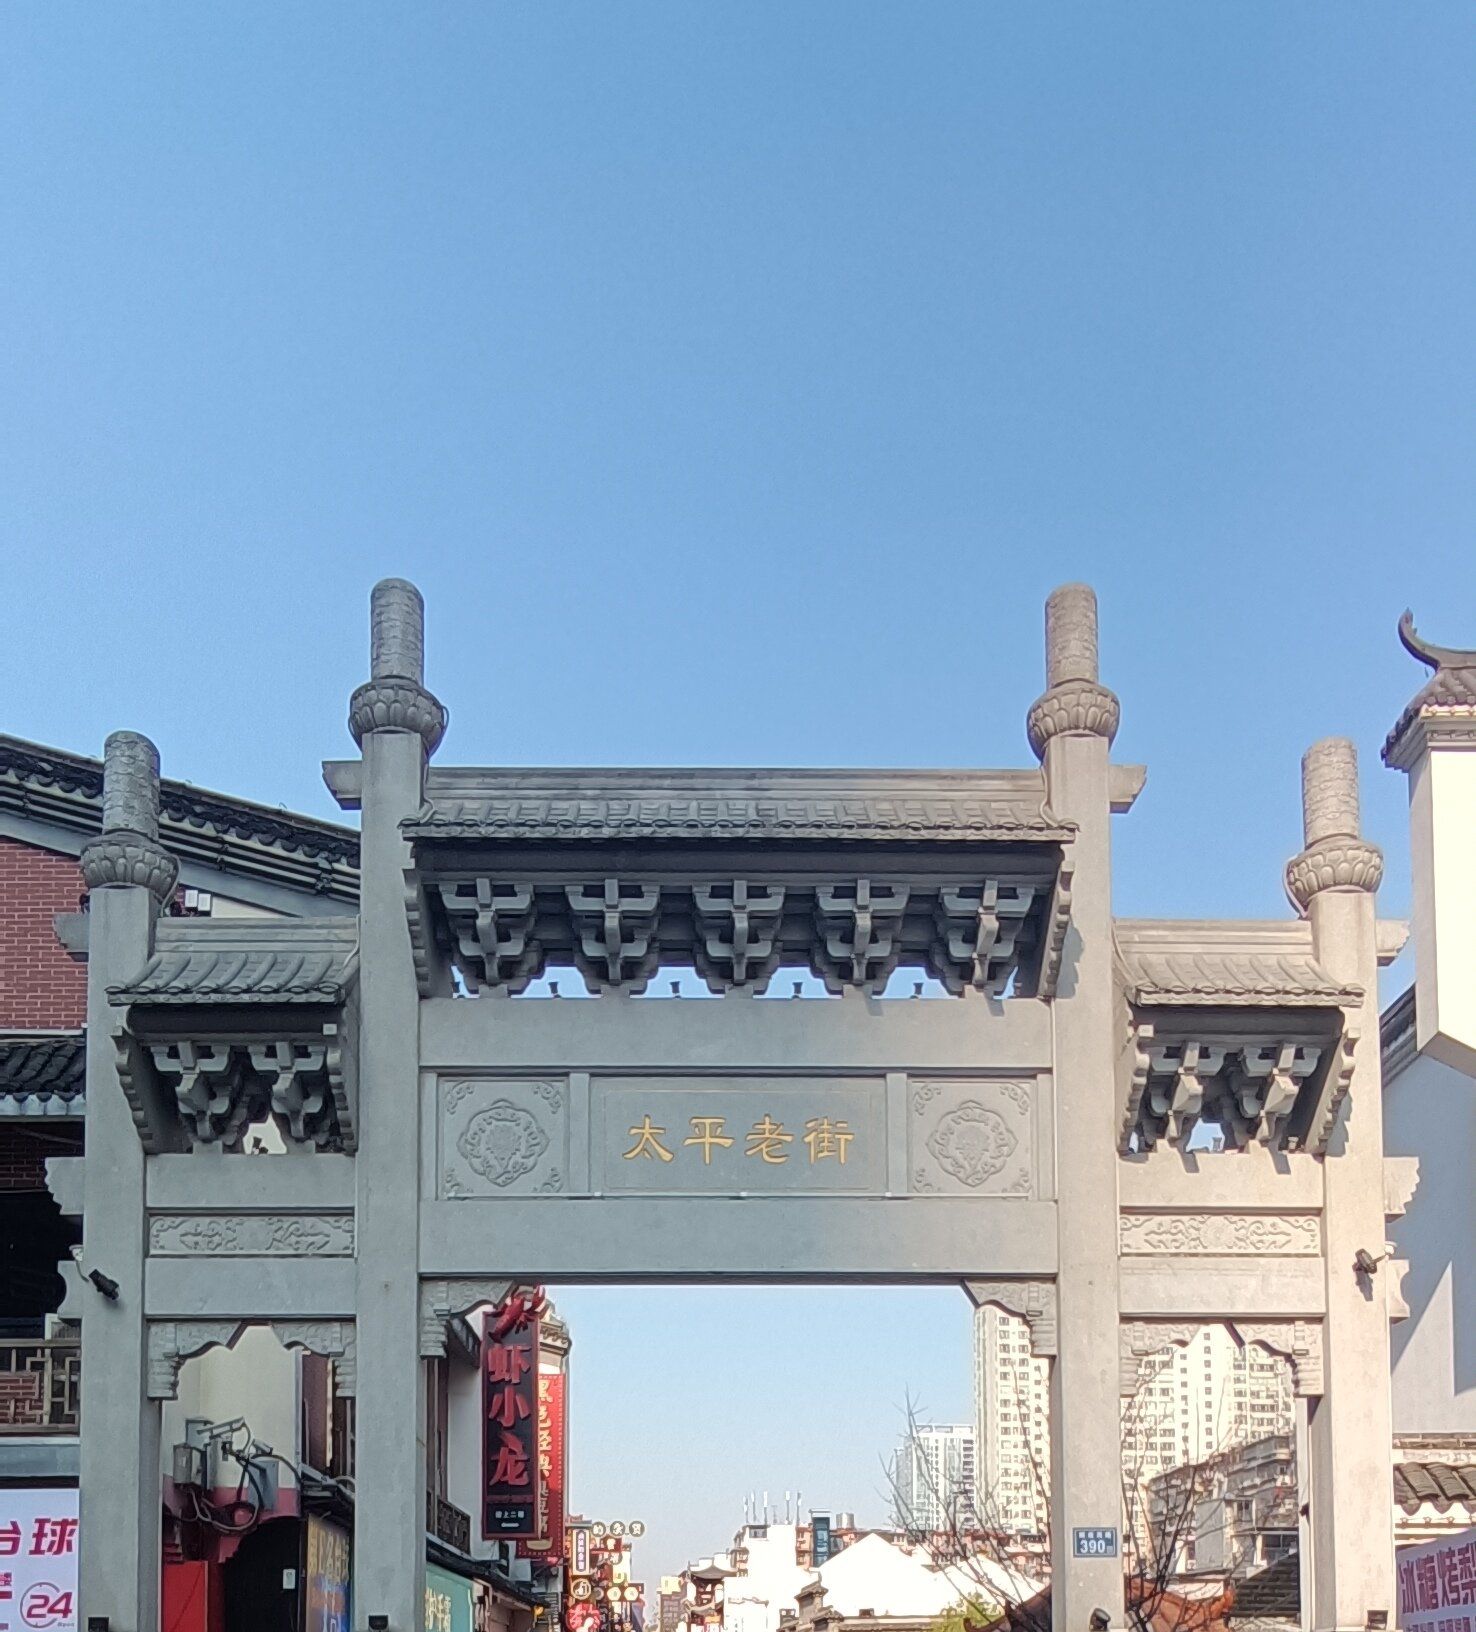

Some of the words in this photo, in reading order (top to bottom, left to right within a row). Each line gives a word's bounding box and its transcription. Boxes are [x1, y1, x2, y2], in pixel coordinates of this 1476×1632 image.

[622, 1113, 856, 1166] 太平老街
[1080, 1539, 1105, 1553] 390
[26, 1591, 73, 1619] 24
